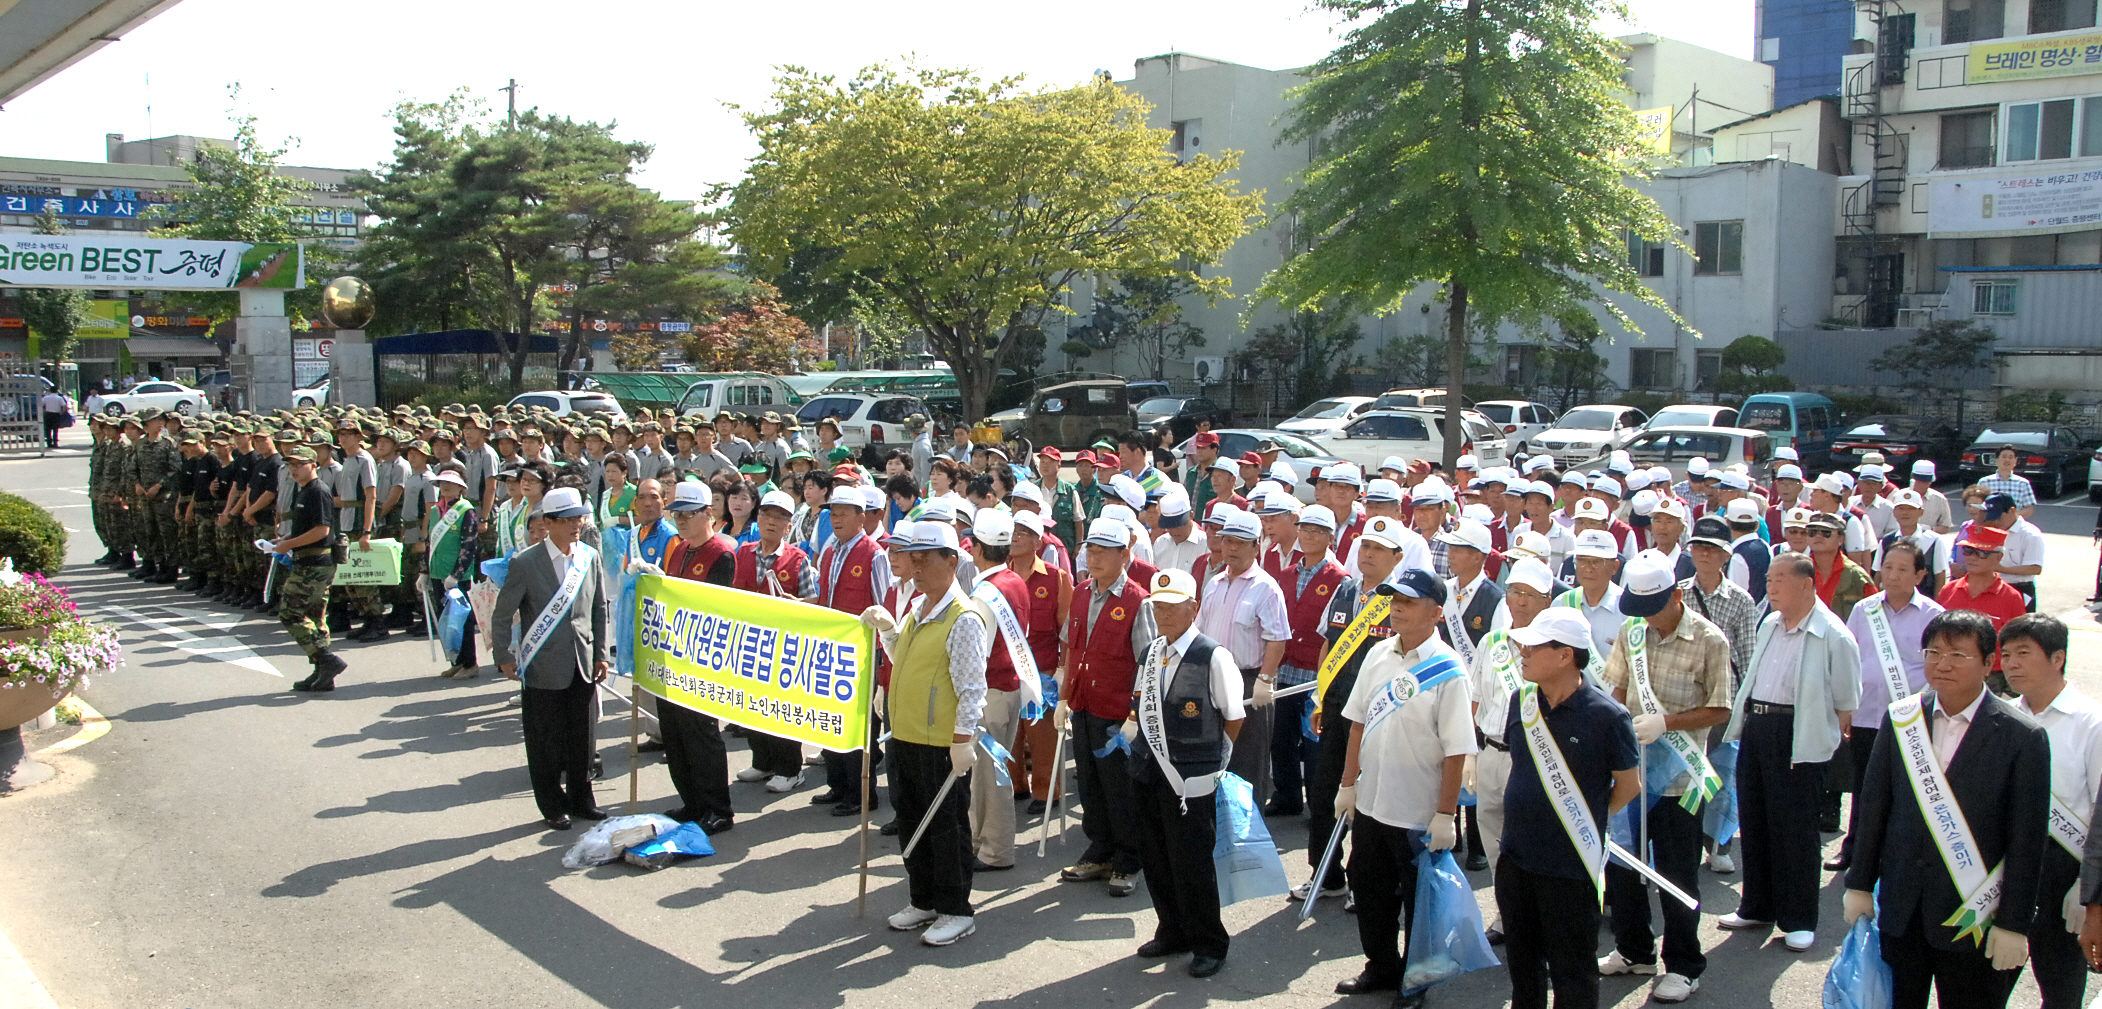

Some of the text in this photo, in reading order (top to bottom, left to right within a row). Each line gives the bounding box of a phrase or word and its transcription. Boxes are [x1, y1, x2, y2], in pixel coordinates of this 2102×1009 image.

[1984, 51, 2036, 70] 브레인
[2047, 174, 2079, 185] 비우고!
[16, 241, 68, 251] 저탄소 녹색도시
[80, 247, 162, 273] BEST
[160, 249, 226, 279] 증평
[551, 595, 569, 615] 사랑
[531, 614, 556, 644] 대청결
[641, 598, 856, 701] 증평노인자원봉사클럽 봉사활동
[1326, 640, 1352, 674] 증평군지회
[1873, 615, 1887, 639] 버리는
[1880, 639, 1895, 661] 쓰레기
[1888, 665, 1903, 690] 버리는
[645, 658, 844, 735] (사)대한노인회증평군지회 노인자원봉사클럽
[1634, 656, 1646, 685] 증평
[1641, 687, 1658, 715] 사랑
[1530, 727, 1597, 850] 탄소포인트제 참여로 온실가스 줄이기
[1904, 725, 1974, 870] 탄소포인트제 참여로 온실가스 줄이기
[2060, 821, 2081, 839] 먼저
